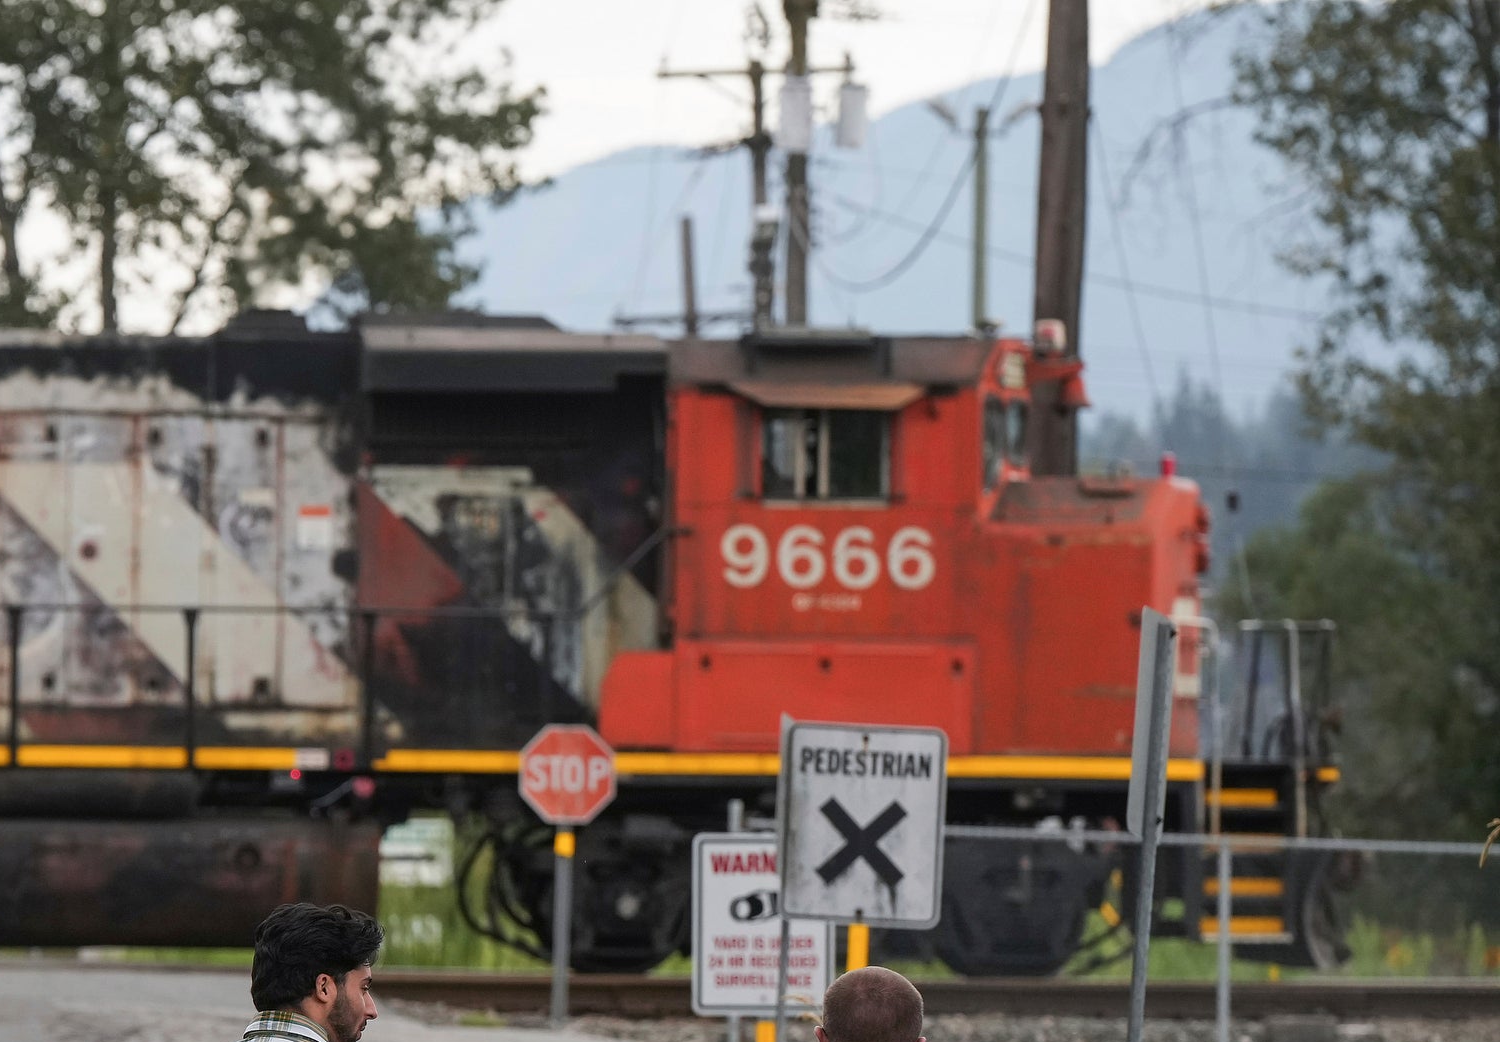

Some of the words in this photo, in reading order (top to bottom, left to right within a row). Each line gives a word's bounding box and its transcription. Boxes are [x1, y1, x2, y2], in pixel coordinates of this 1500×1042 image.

[720, 524, 936, 590] 9666
[525, 754, 610, 793] STOP
[800, 747, 933, 781] PEDESTRIAN
[709, 851, 777, 874] WARN
[750, 955, 818, 968] RECODED
[715, 974, 812, 988] SURVEILLNCE
